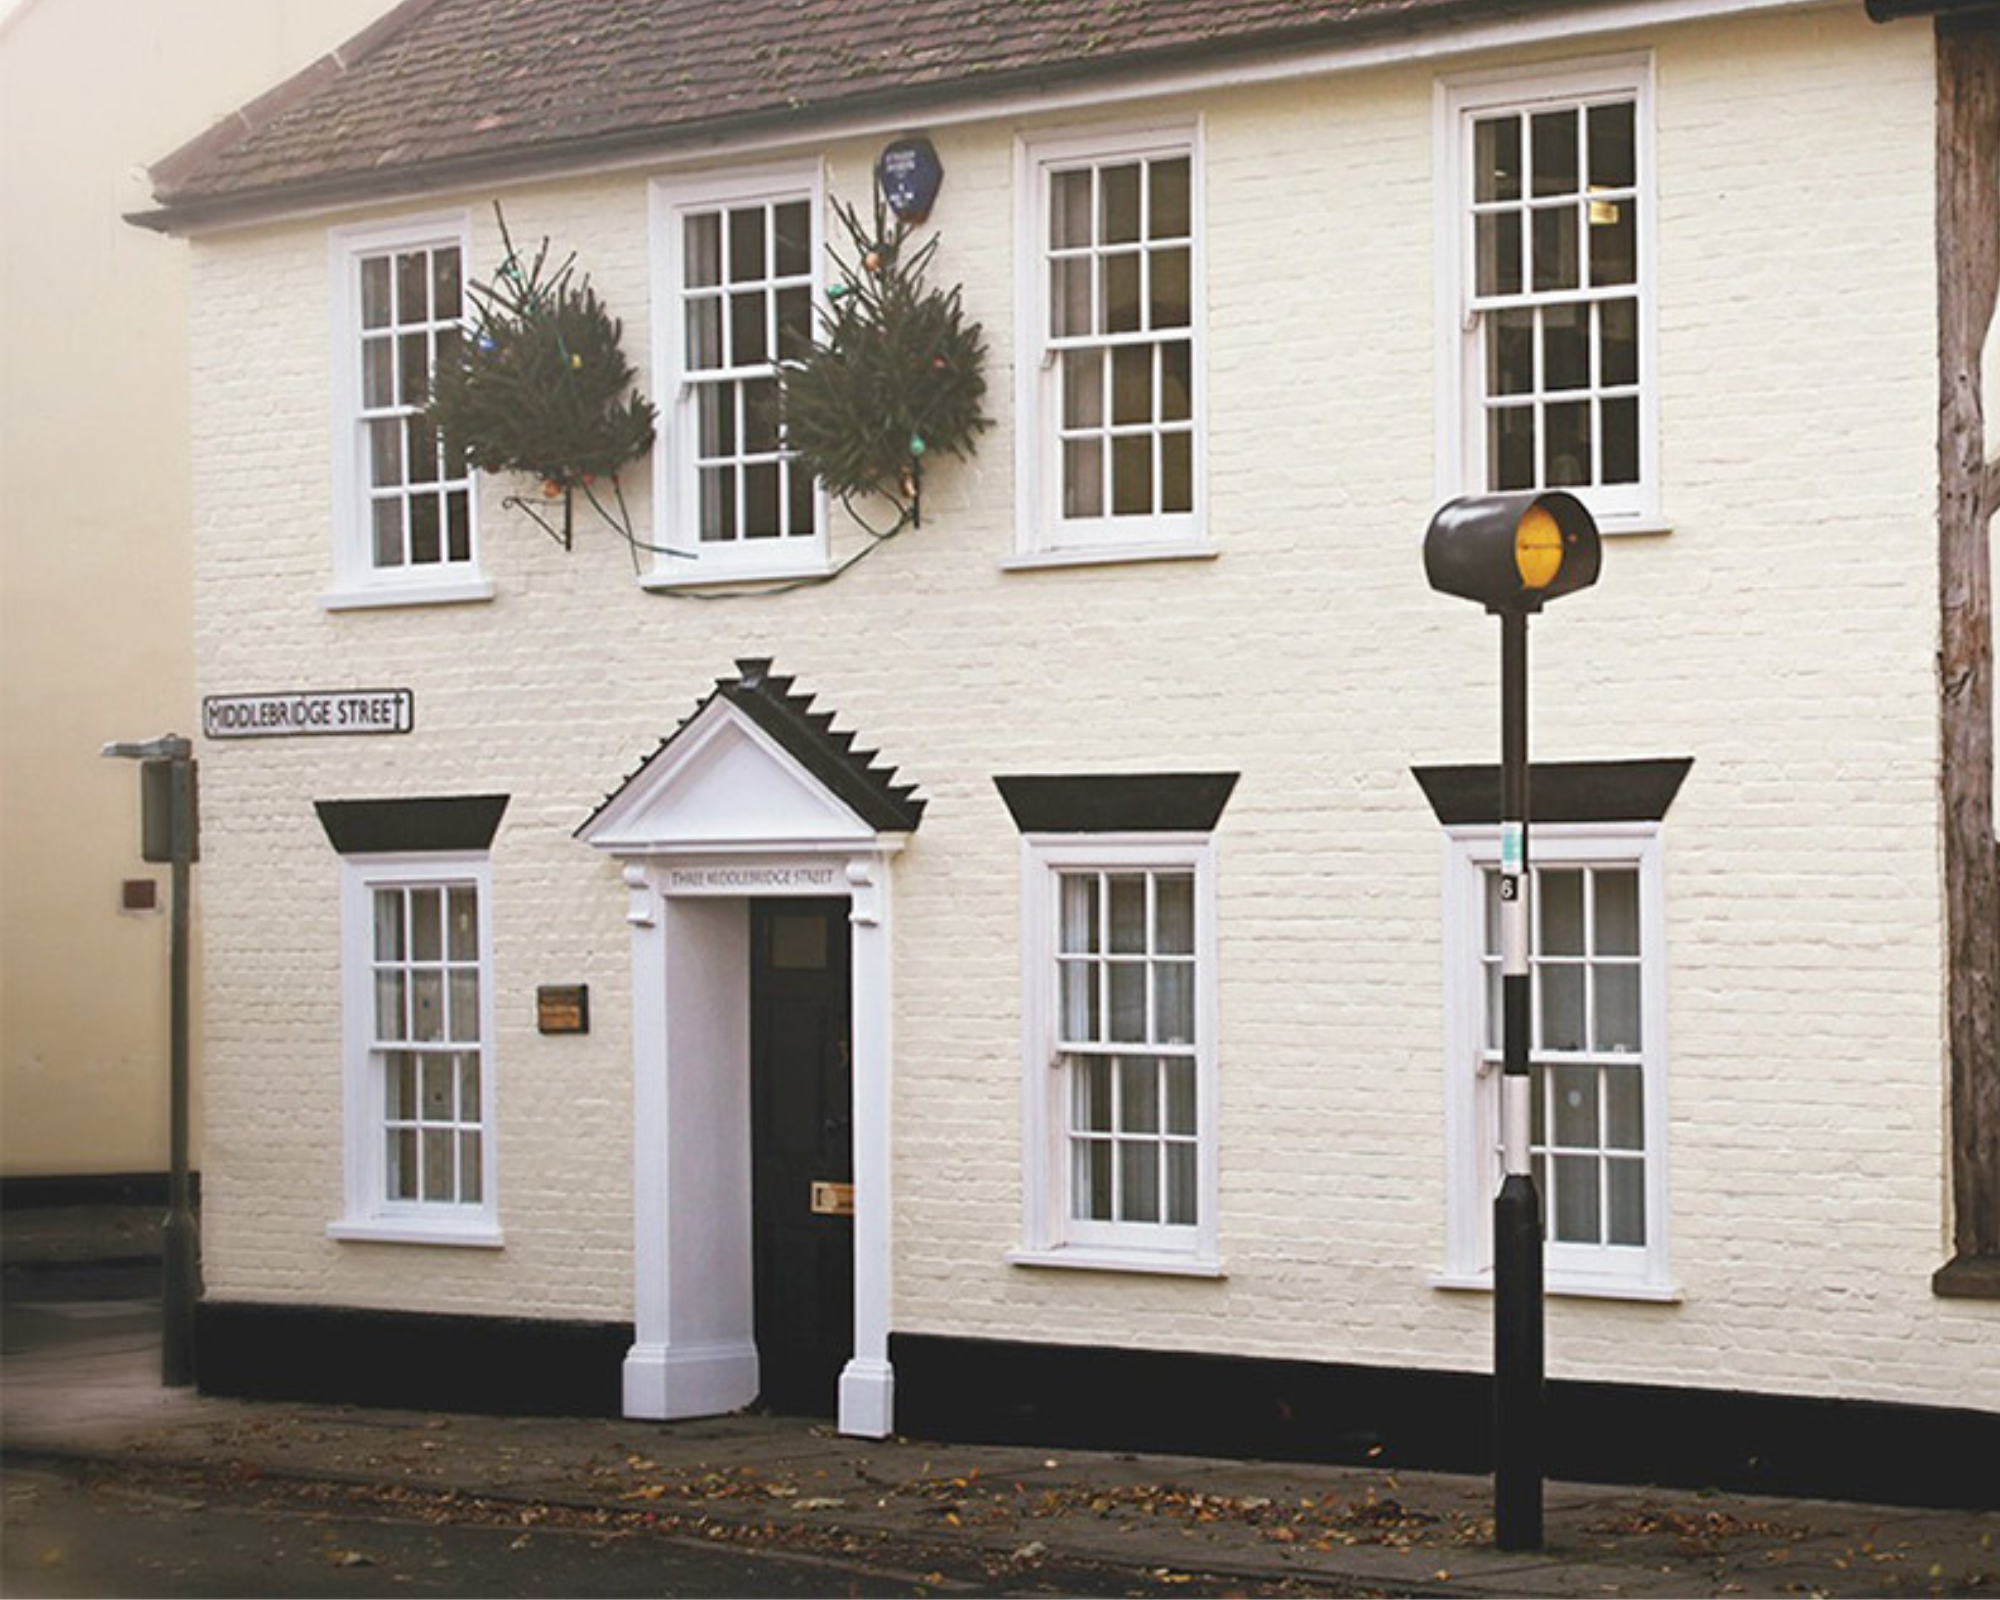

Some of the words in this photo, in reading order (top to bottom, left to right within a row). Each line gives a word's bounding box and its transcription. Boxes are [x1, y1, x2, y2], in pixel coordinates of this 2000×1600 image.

[209, 701, 331, 728] MIDDLEBRIDGE
[337, 698, 404, 725] STREET
[706, 870, 791, 886] MIDDLEBRIDGE
[794, 868, 834, 884] STREET
